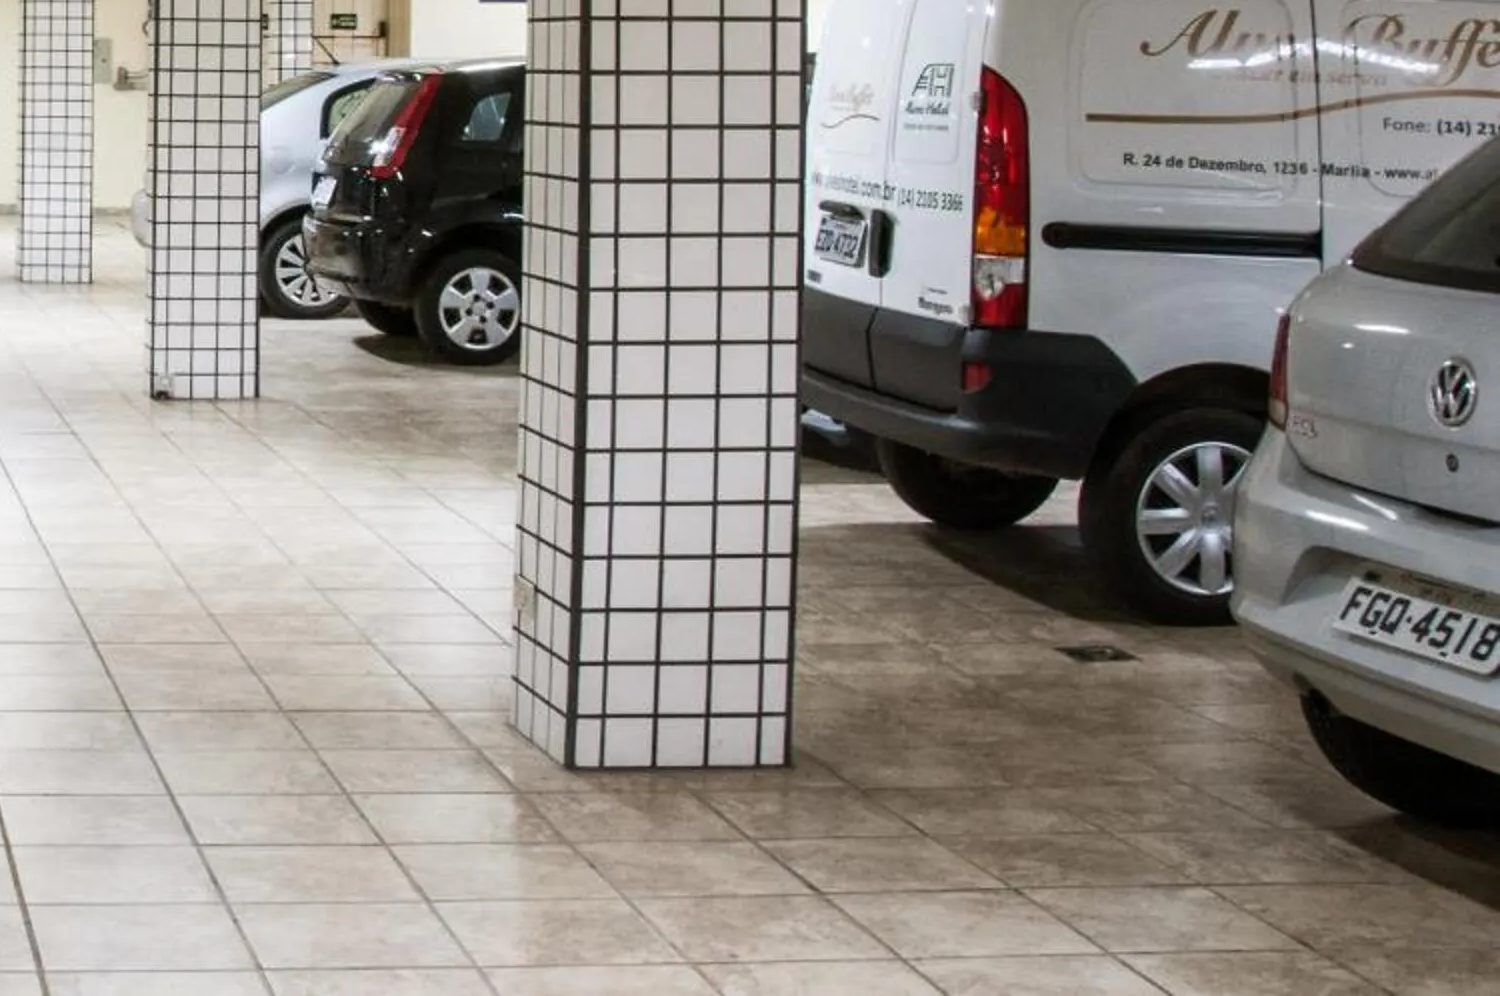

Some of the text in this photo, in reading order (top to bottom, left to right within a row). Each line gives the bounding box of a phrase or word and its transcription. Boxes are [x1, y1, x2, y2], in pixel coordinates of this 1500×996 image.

[1383, 117, 1431, 134] Fone:
[1437, 118, 1472, 137] (14)
[1123, 153, 1137, 166] R.
[1143, 154, 1161, 168] 24
[1165, 155, 1184, 169] de
[1188, 156, 1266, 174] Dezembro,
[1273, 161, 1308, 175] 1236
